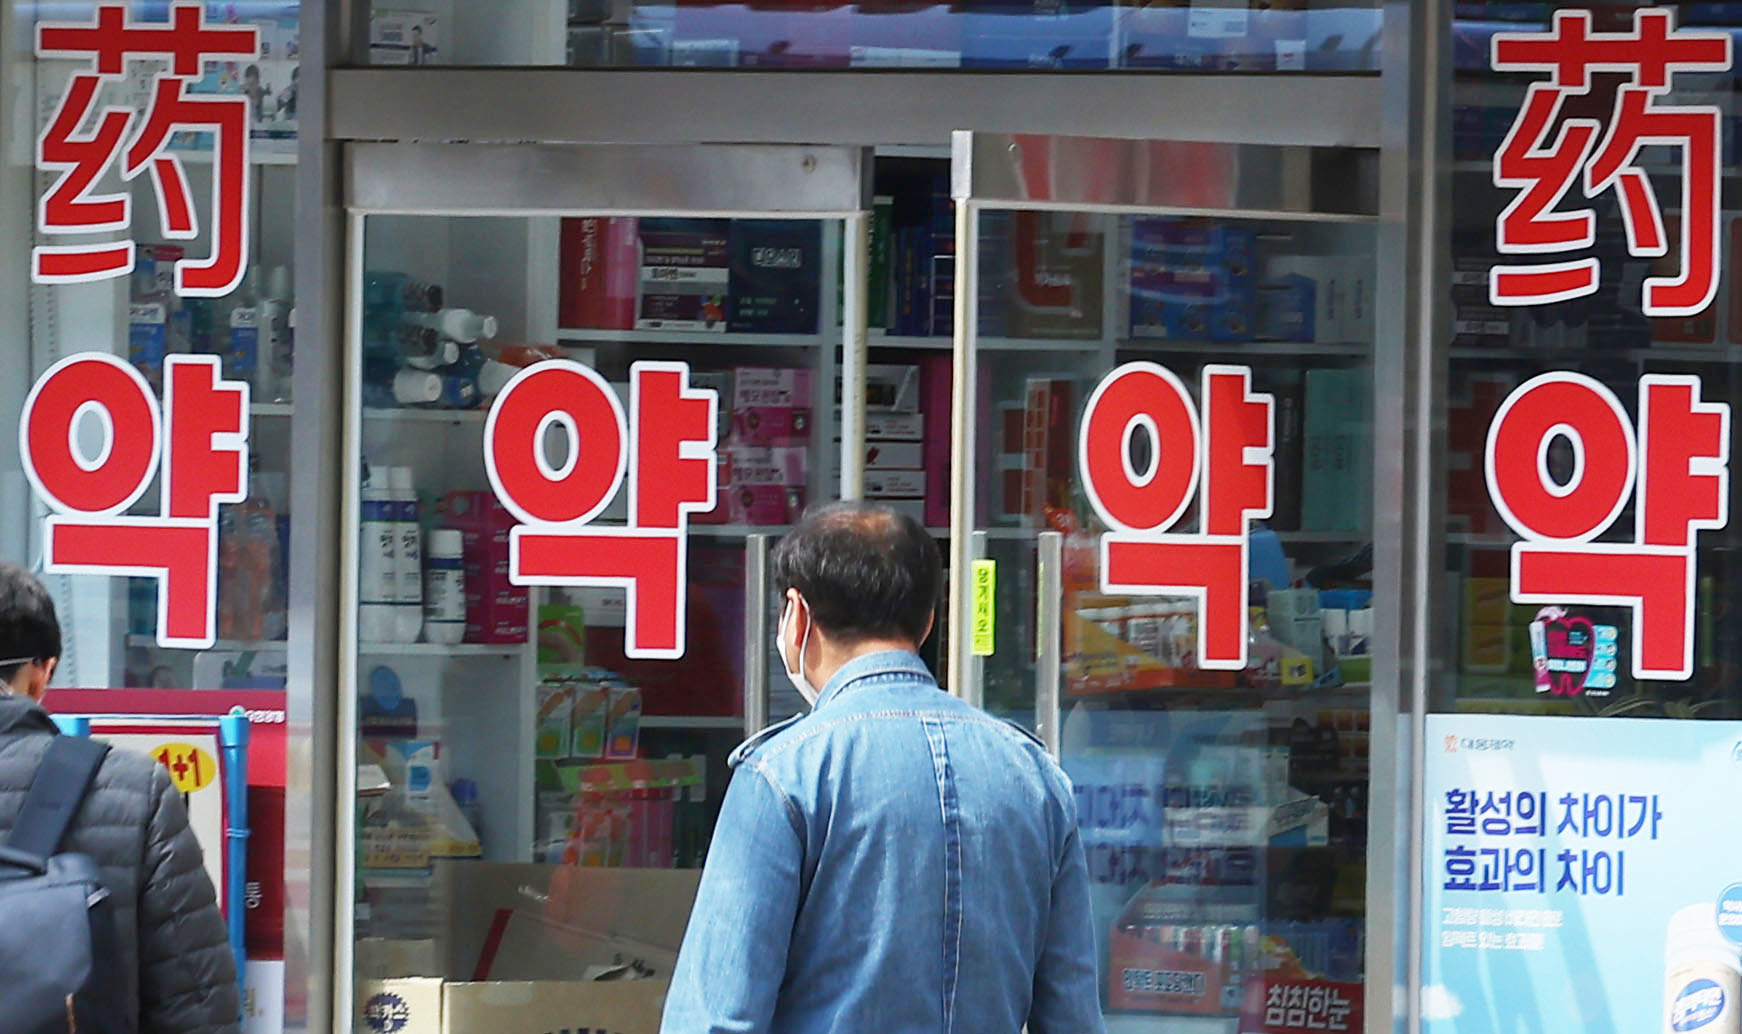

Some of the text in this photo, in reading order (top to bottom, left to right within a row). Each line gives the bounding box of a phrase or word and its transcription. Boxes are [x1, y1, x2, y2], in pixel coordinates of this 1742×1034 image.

[33, 1, 261, 298] 药
[1489, 8, 1733, 317] 药
[19, 352, 250, 650] 약
[484, 359, 719, 660] 약
[1079, 361, 1275, 671] 약
[1485, 370, 1731, 681] 약
[1443, 845, 1625, 897] 효과의 차이
[1444, 787, 1664, 840] 활성의 차이가
